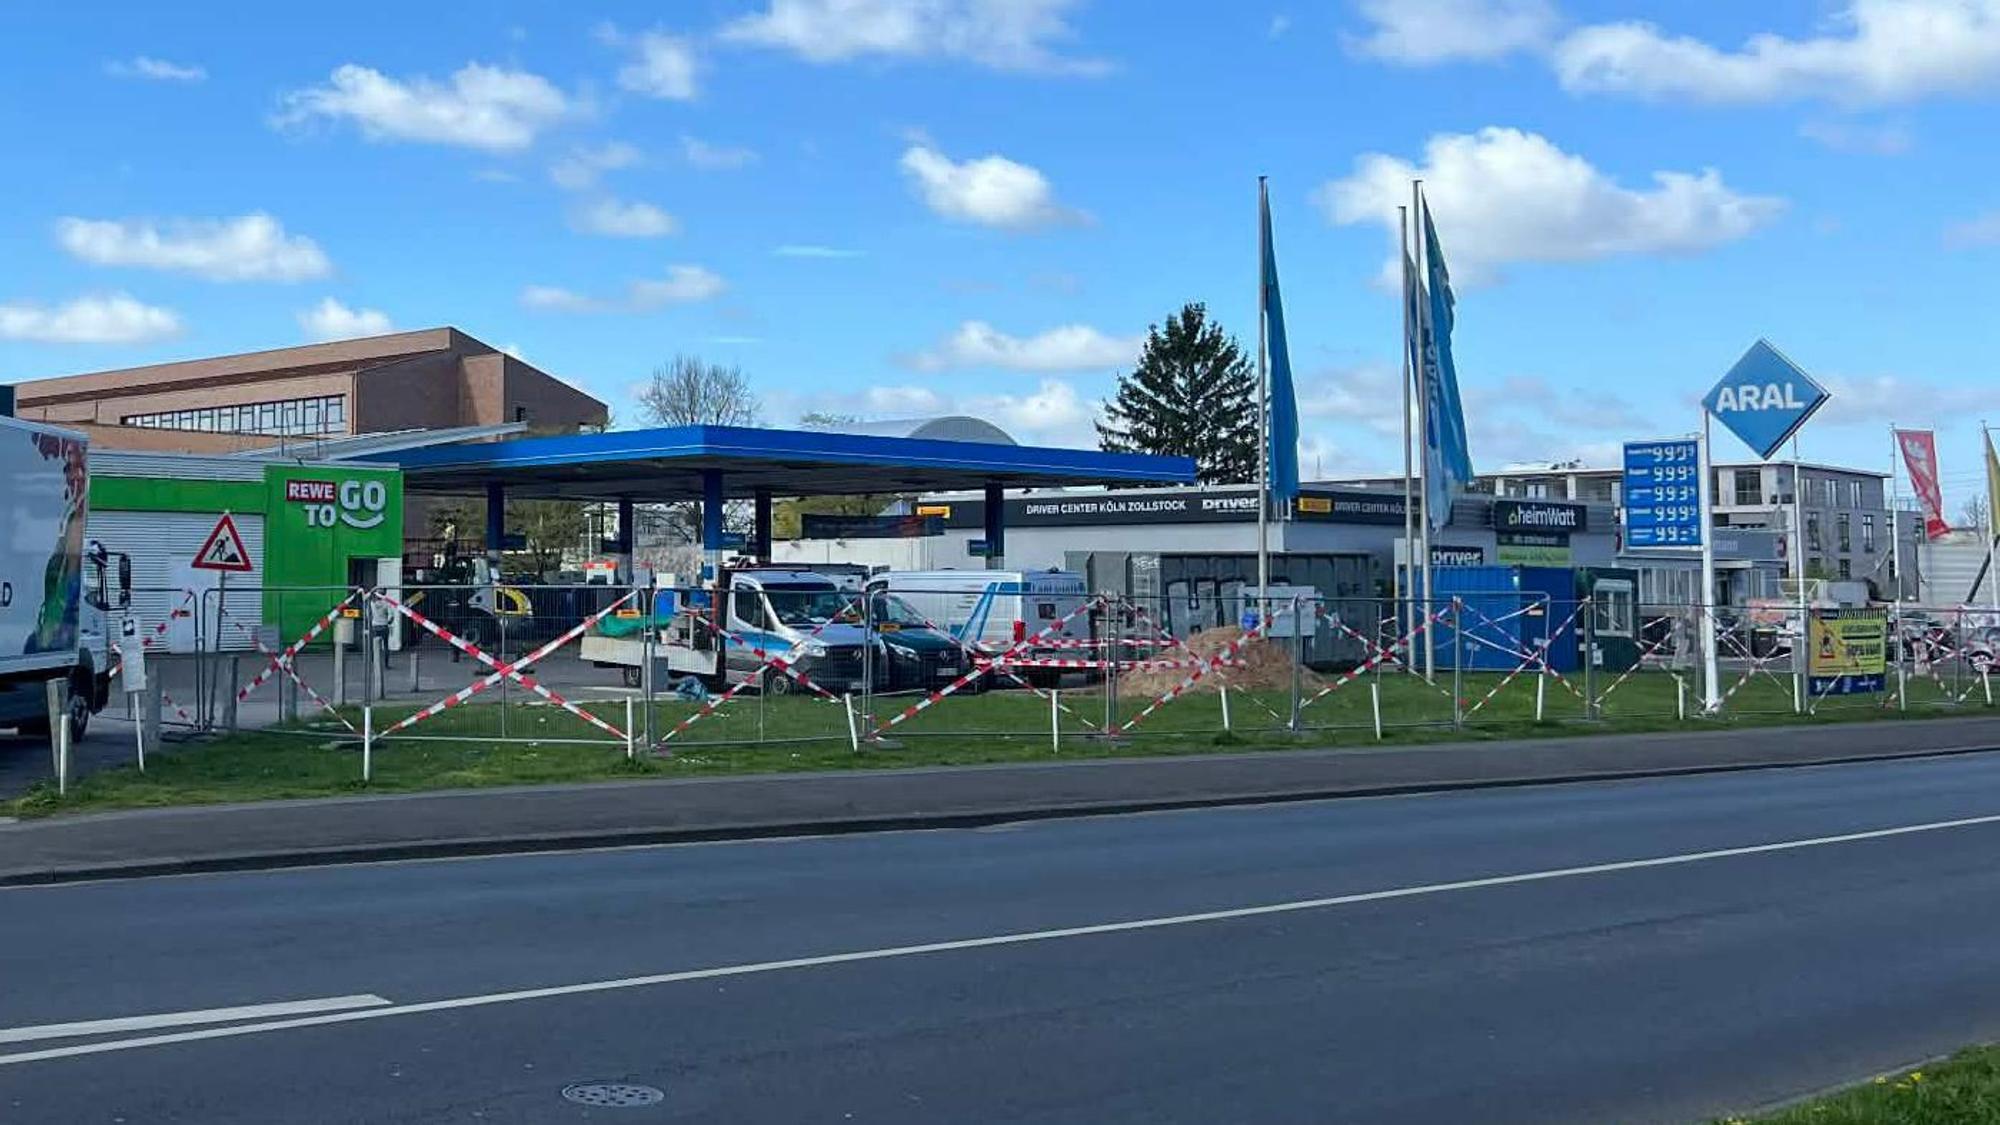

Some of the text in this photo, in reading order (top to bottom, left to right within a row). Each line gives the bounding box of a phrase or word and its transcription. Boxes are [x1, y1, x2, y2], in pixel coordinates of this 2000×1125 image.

[1716, 383, 1805, 412] ARAL
[289, 483, 334, 499] REWE
[340, 480, 386, 511] GO
[305, 504, 337, 527] TO
[1026, 500, 1186, 514] DRIVER CENTER KÖLN ZOLLSTOCK
[1517, 504, 1576, 526] heimWatt
